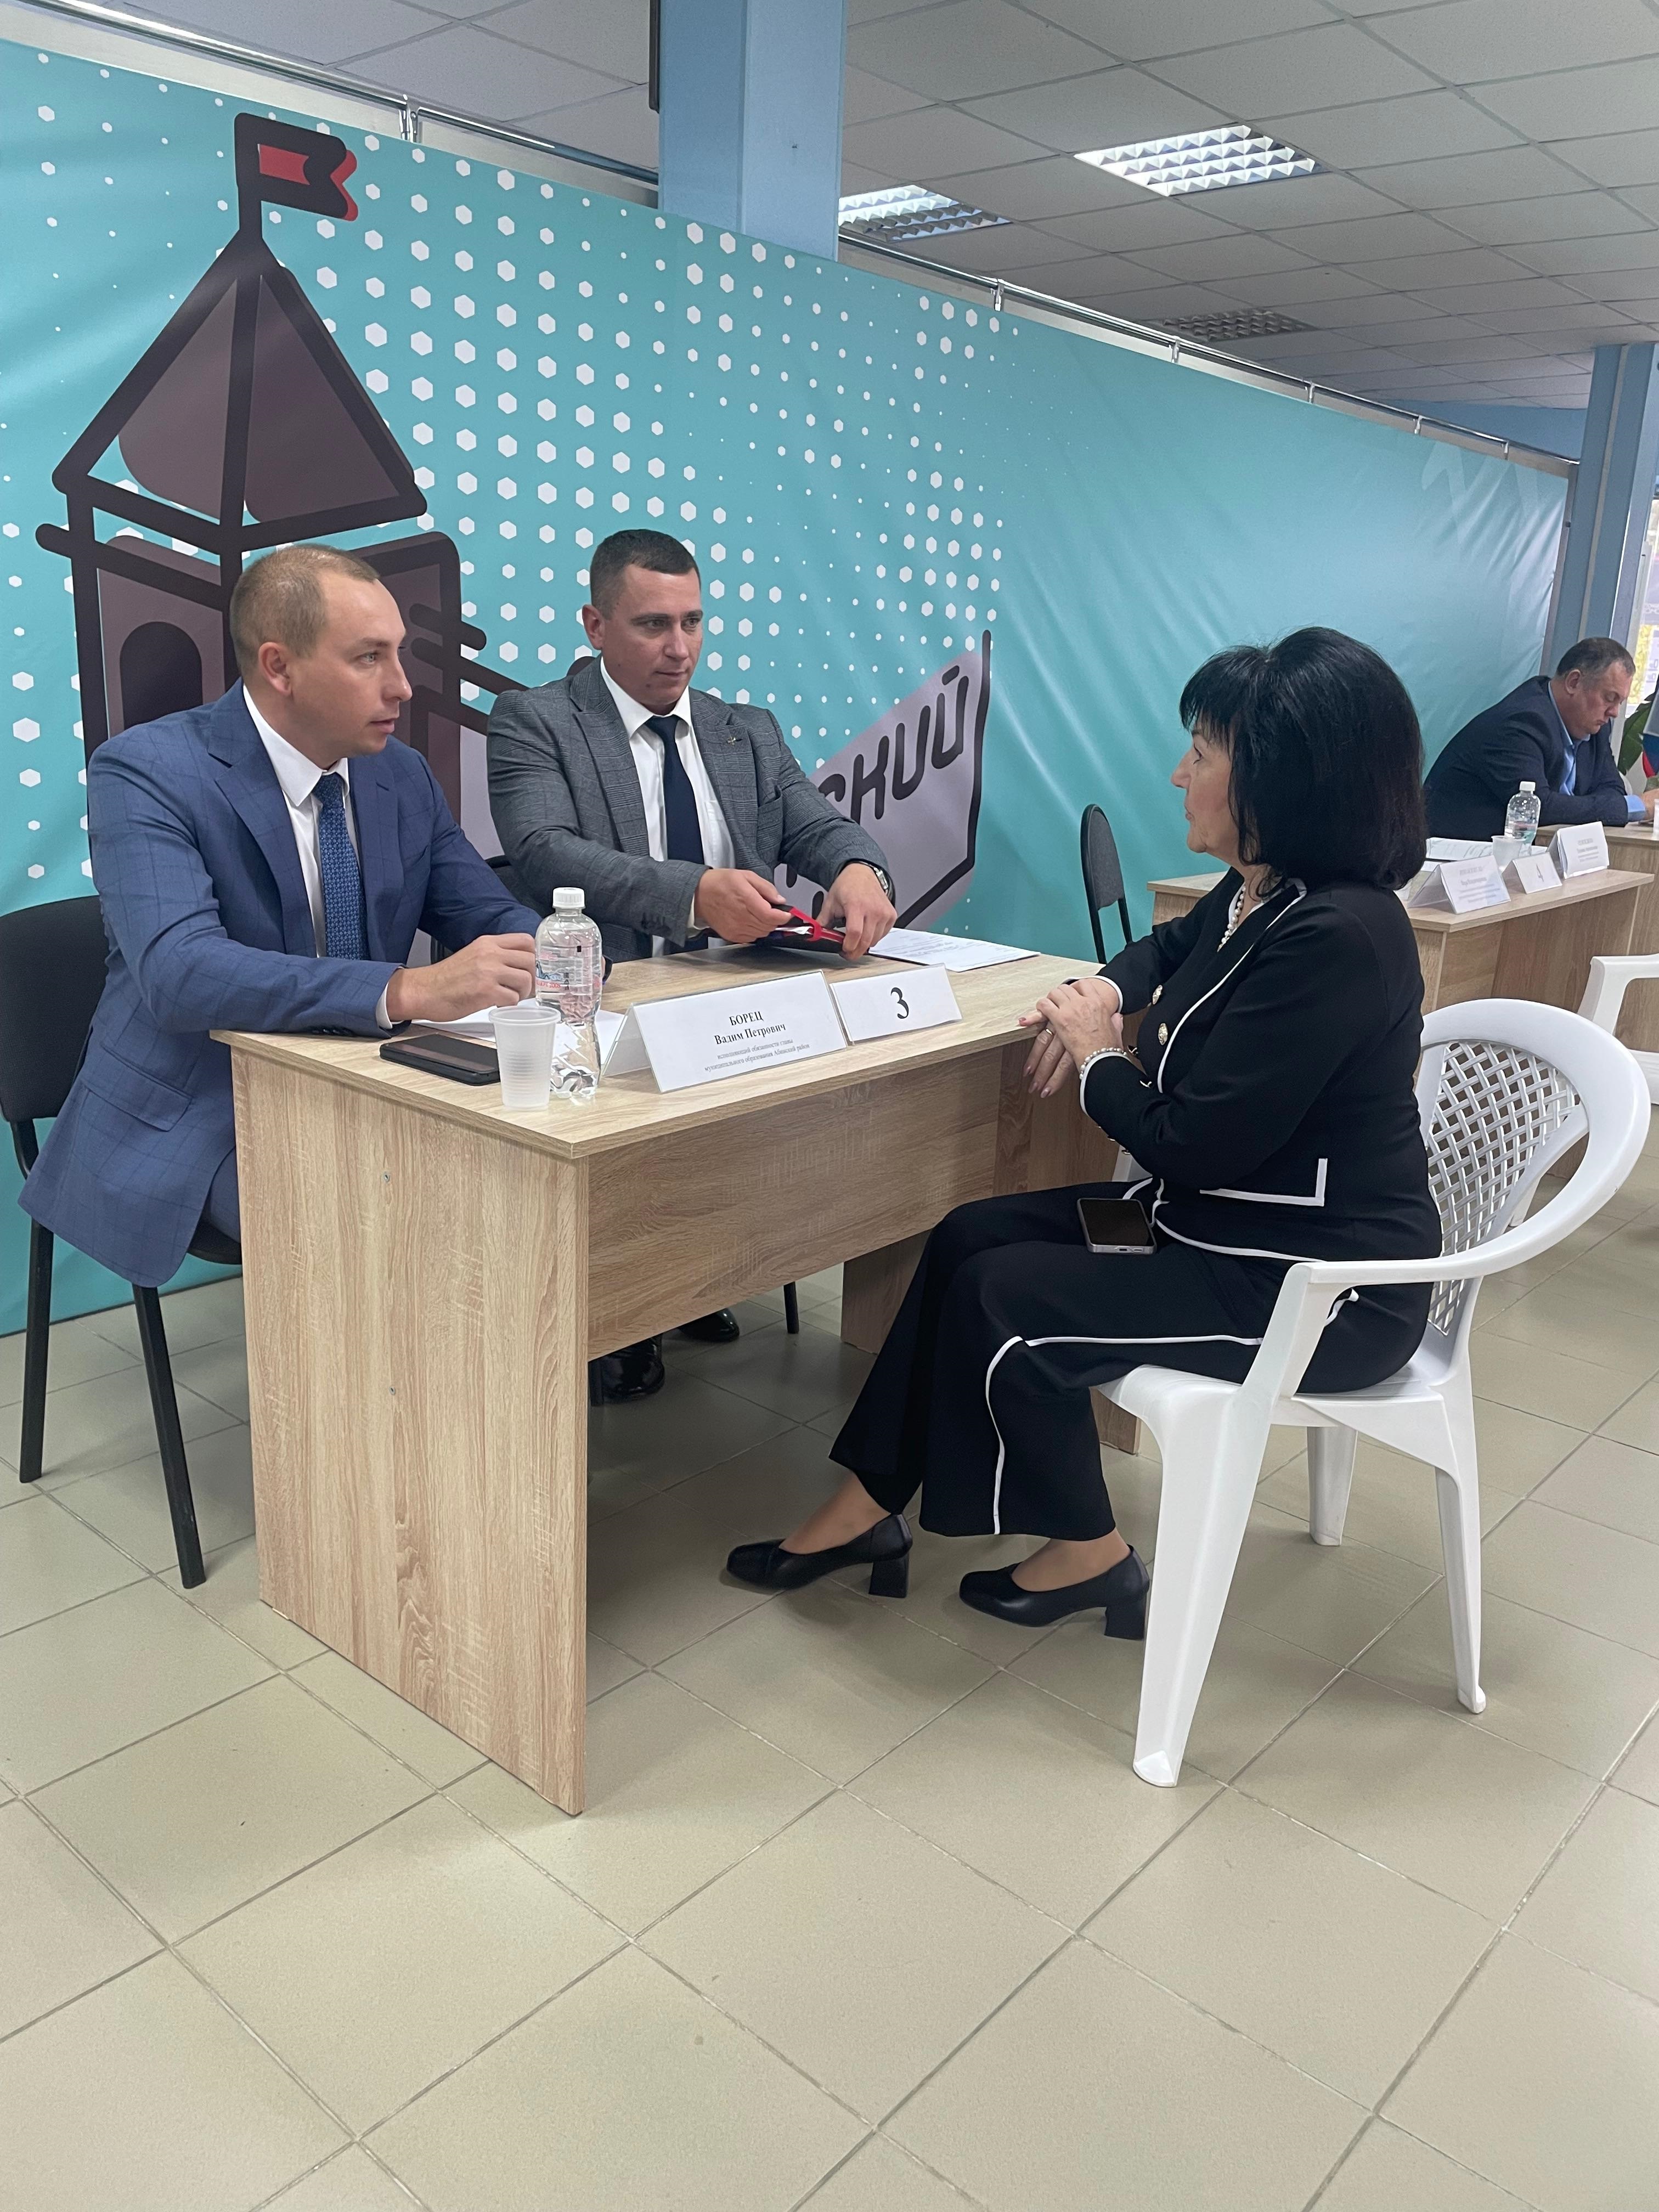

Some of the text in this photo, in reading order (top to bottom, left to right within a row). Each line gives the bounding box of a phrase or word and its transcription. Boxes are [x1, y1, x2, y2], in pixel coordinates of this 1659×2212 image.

[890, 987, 909, 1019] 3
[729, 1011, 764, 1026] БОРЕЦ
[714, 1024, 786, 1045] Вадим Петрович
